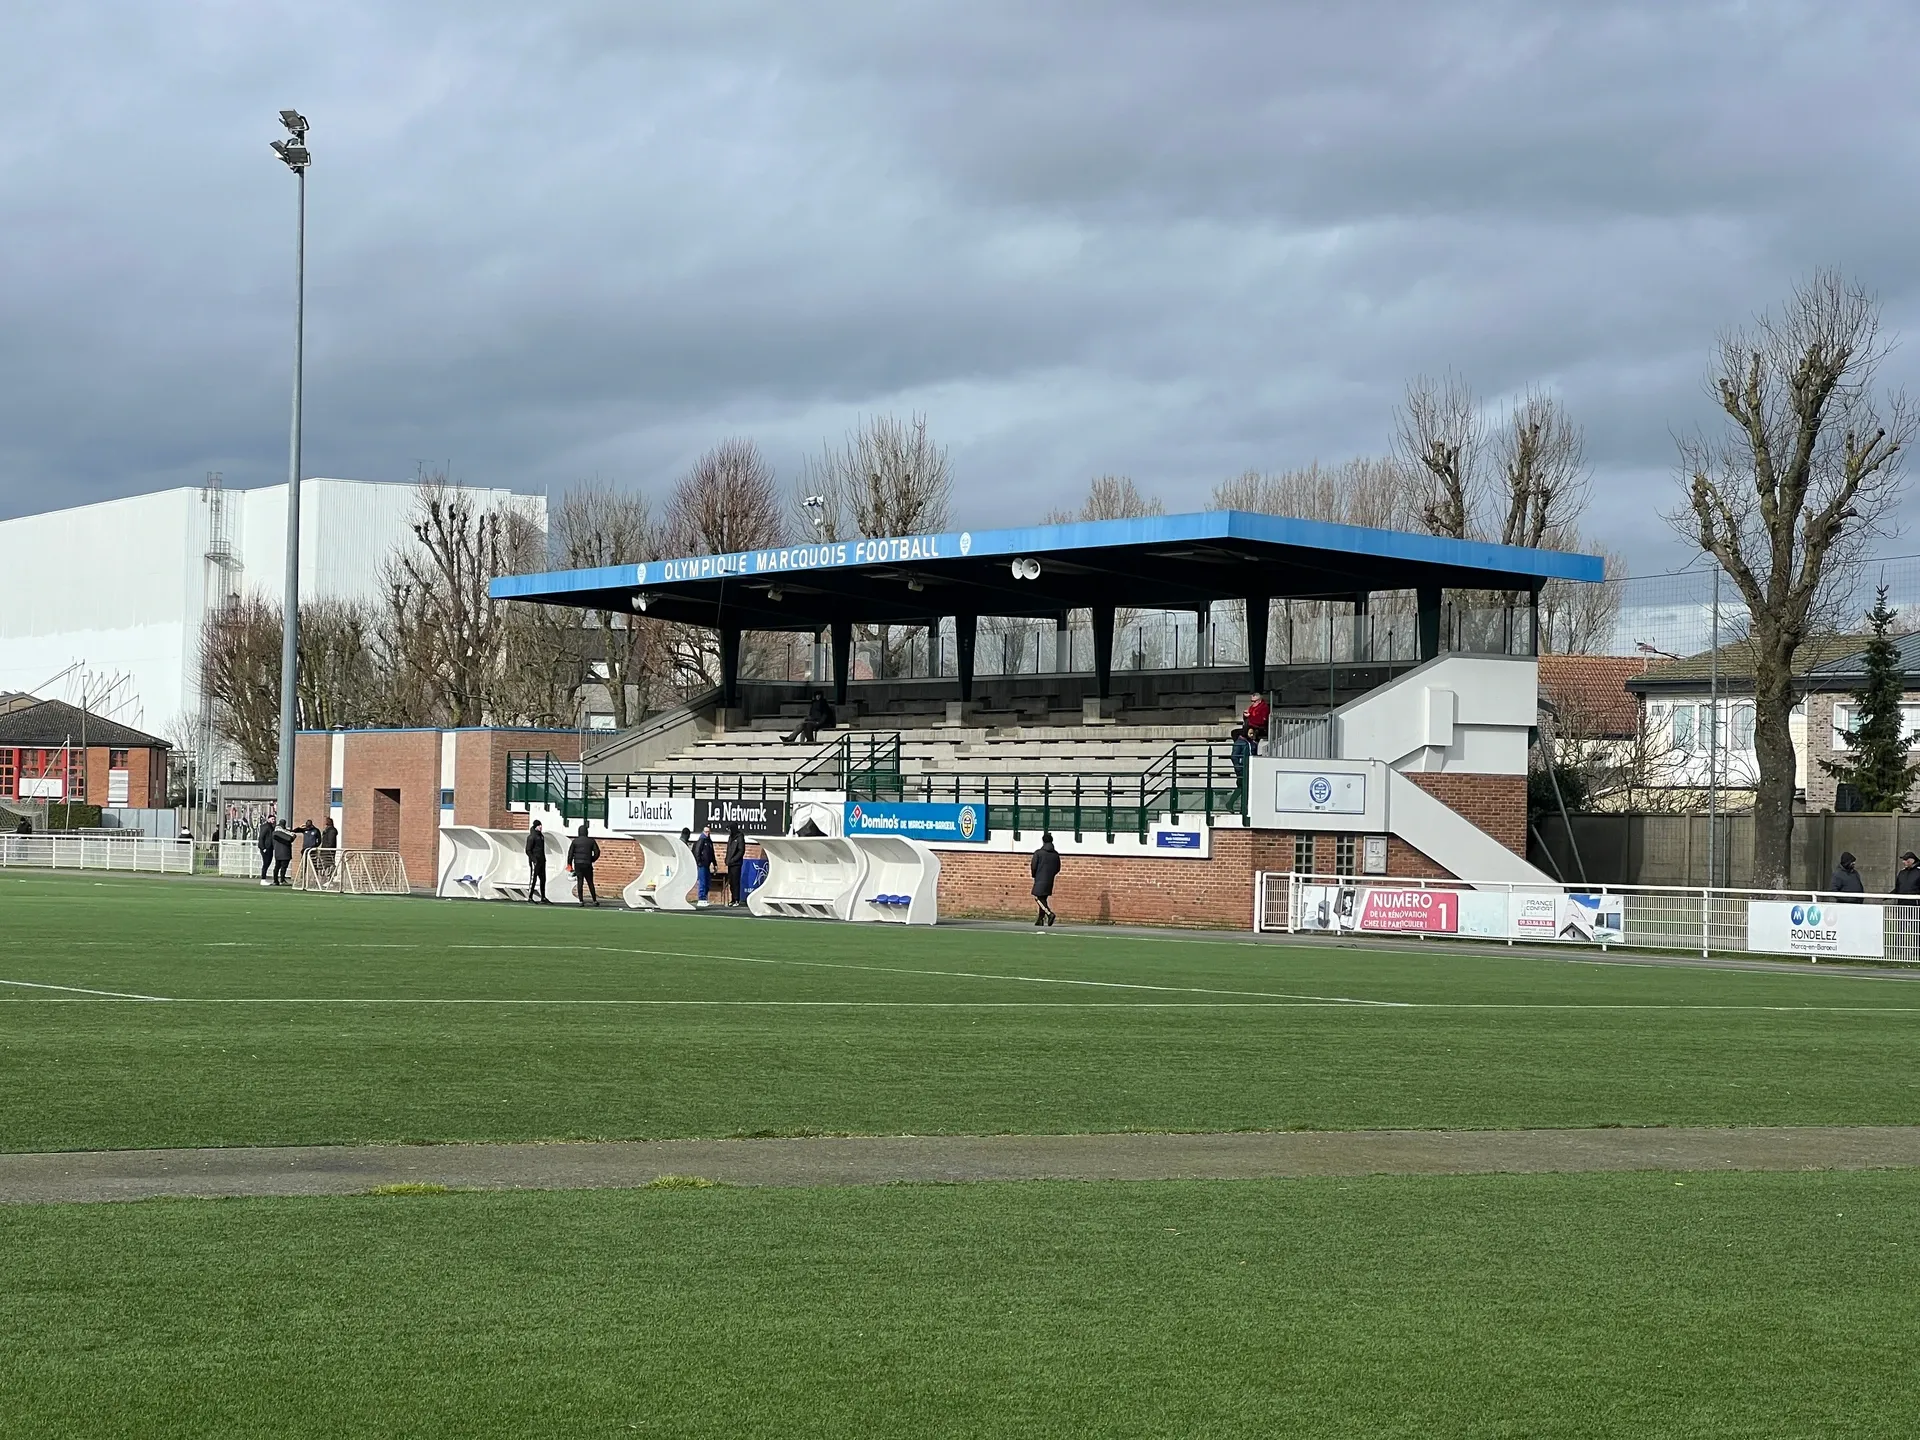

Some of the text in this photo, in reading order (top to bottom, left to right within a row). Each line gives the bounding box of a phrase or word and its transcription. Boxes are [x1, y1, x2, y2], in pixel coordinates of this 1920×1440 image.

[664, 537, 939, 580] OLYMPIQUE MARCQUOIS FOOTBALL
[628, 800, 673, 820] Le Nautik
[707, 801, 767, 822] Le Network
[861, 813, 899, 830] Domino's
[1373, 893, 1432, 908] NUMERO
[1370, 910, 1378, 918] DE
[1388, 910, 1427, 918] RÉNOVATION
[1438, 903, 1447, 930] 1
[1380, 920, 1387, 928] LE
[1791, 929, 1837, 940] RONDELEZ
